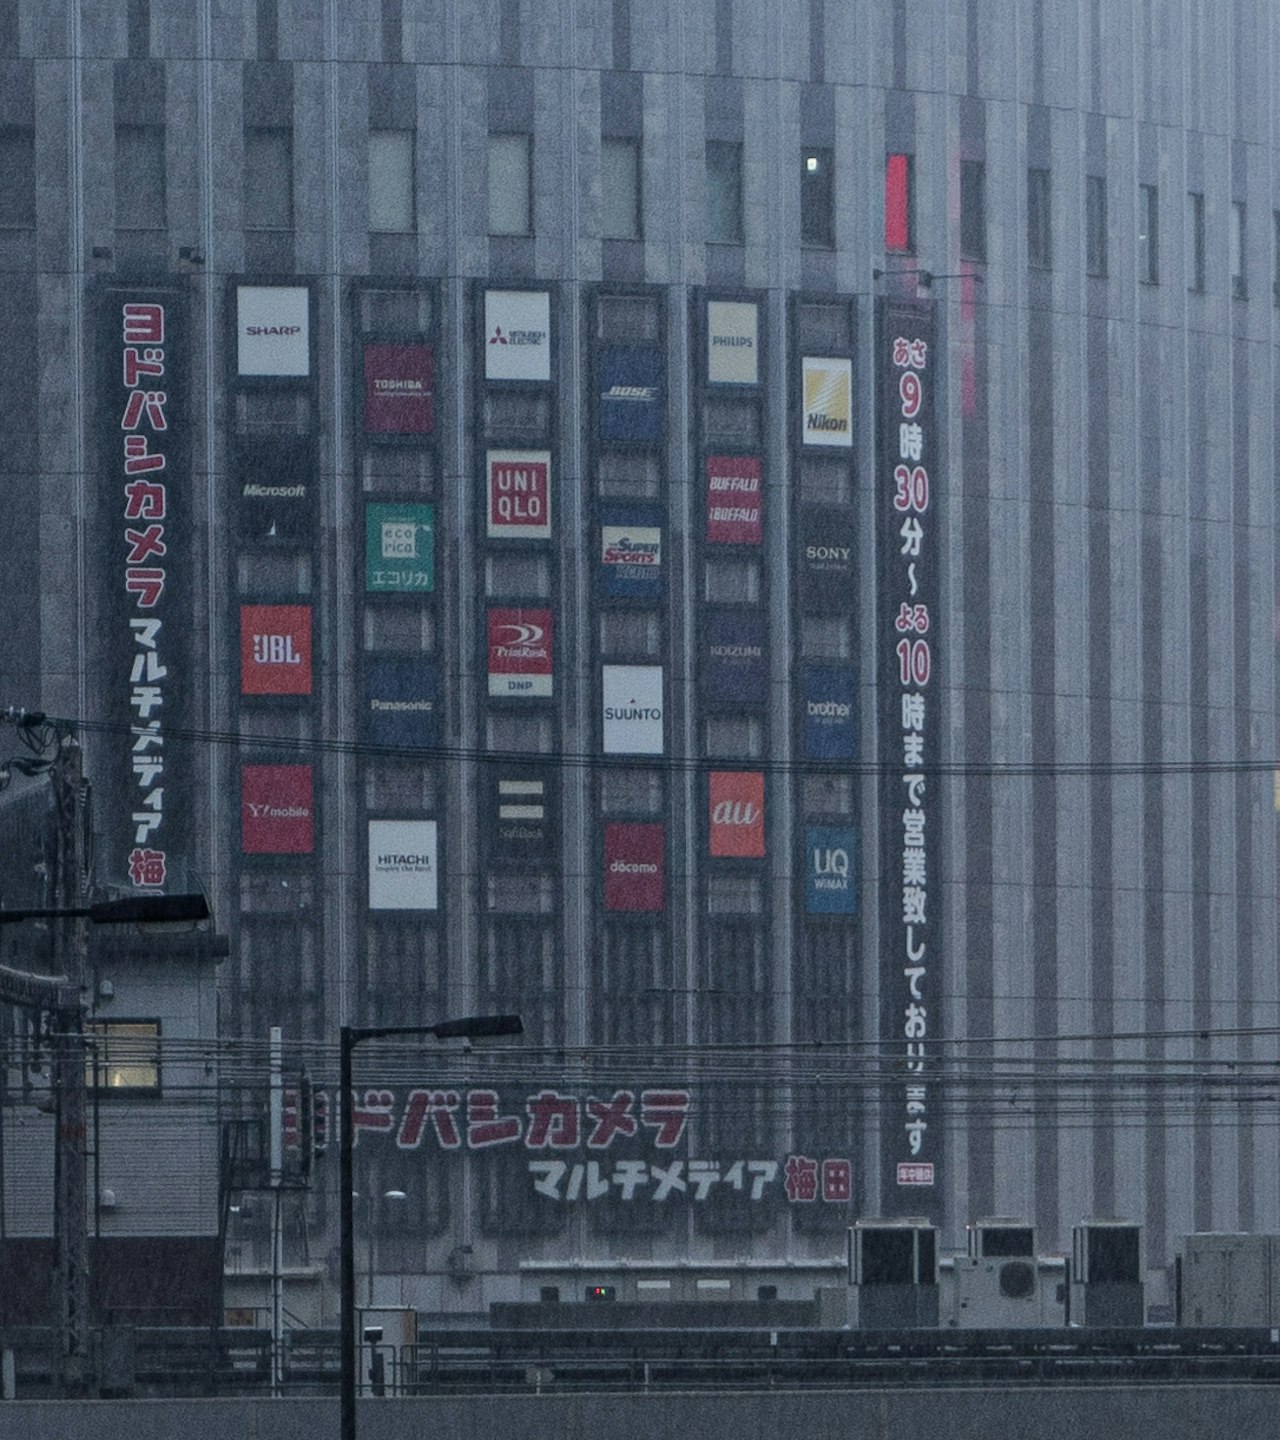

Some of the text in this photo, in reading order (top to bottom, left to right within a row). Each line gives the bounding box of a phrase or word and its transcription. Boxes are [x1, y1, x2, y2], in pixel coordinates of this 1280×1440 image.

[246, 325, 301, 336] SHARP
[712, 336, 753, 348] PHILIPS
[374, 379, 422, 389] TOSHIBA
[608, 385, 656, 398] BOSE
[807, 413, 848, 433] Nikon
[497, 470, 536, 492] UNI
[709, 476, 758, 491] BUFFALO
[243, 482, 306, 497] Microsoft
[498, 496, 541, 520] QLO
[384, 528, 413, 539] eco
[384, 541, 413, 553] rica
[806, 546, 851, 560] SONY
[372, 570, 429, 586] エコリカ
[253, 634, 300, 663] JBL
[709, 645, 761, 657] KOIZUMI
[508, 681, 533, 690] DNP
[370, 699, 433, 711] Panasonic
[807, 700, 852, 716] brother
[604, 707, 662, 722] SUUNTO
[712, 800, 760, 826] au
[378, 855, 430, 865] HITACHI
[610, 860, 657, 874] docomo
[813, 848, 849, 876] UQ
[814, 878, 849, 890] WiMAX
[528, 1156, 852, 1202] マルチメディア梅田
